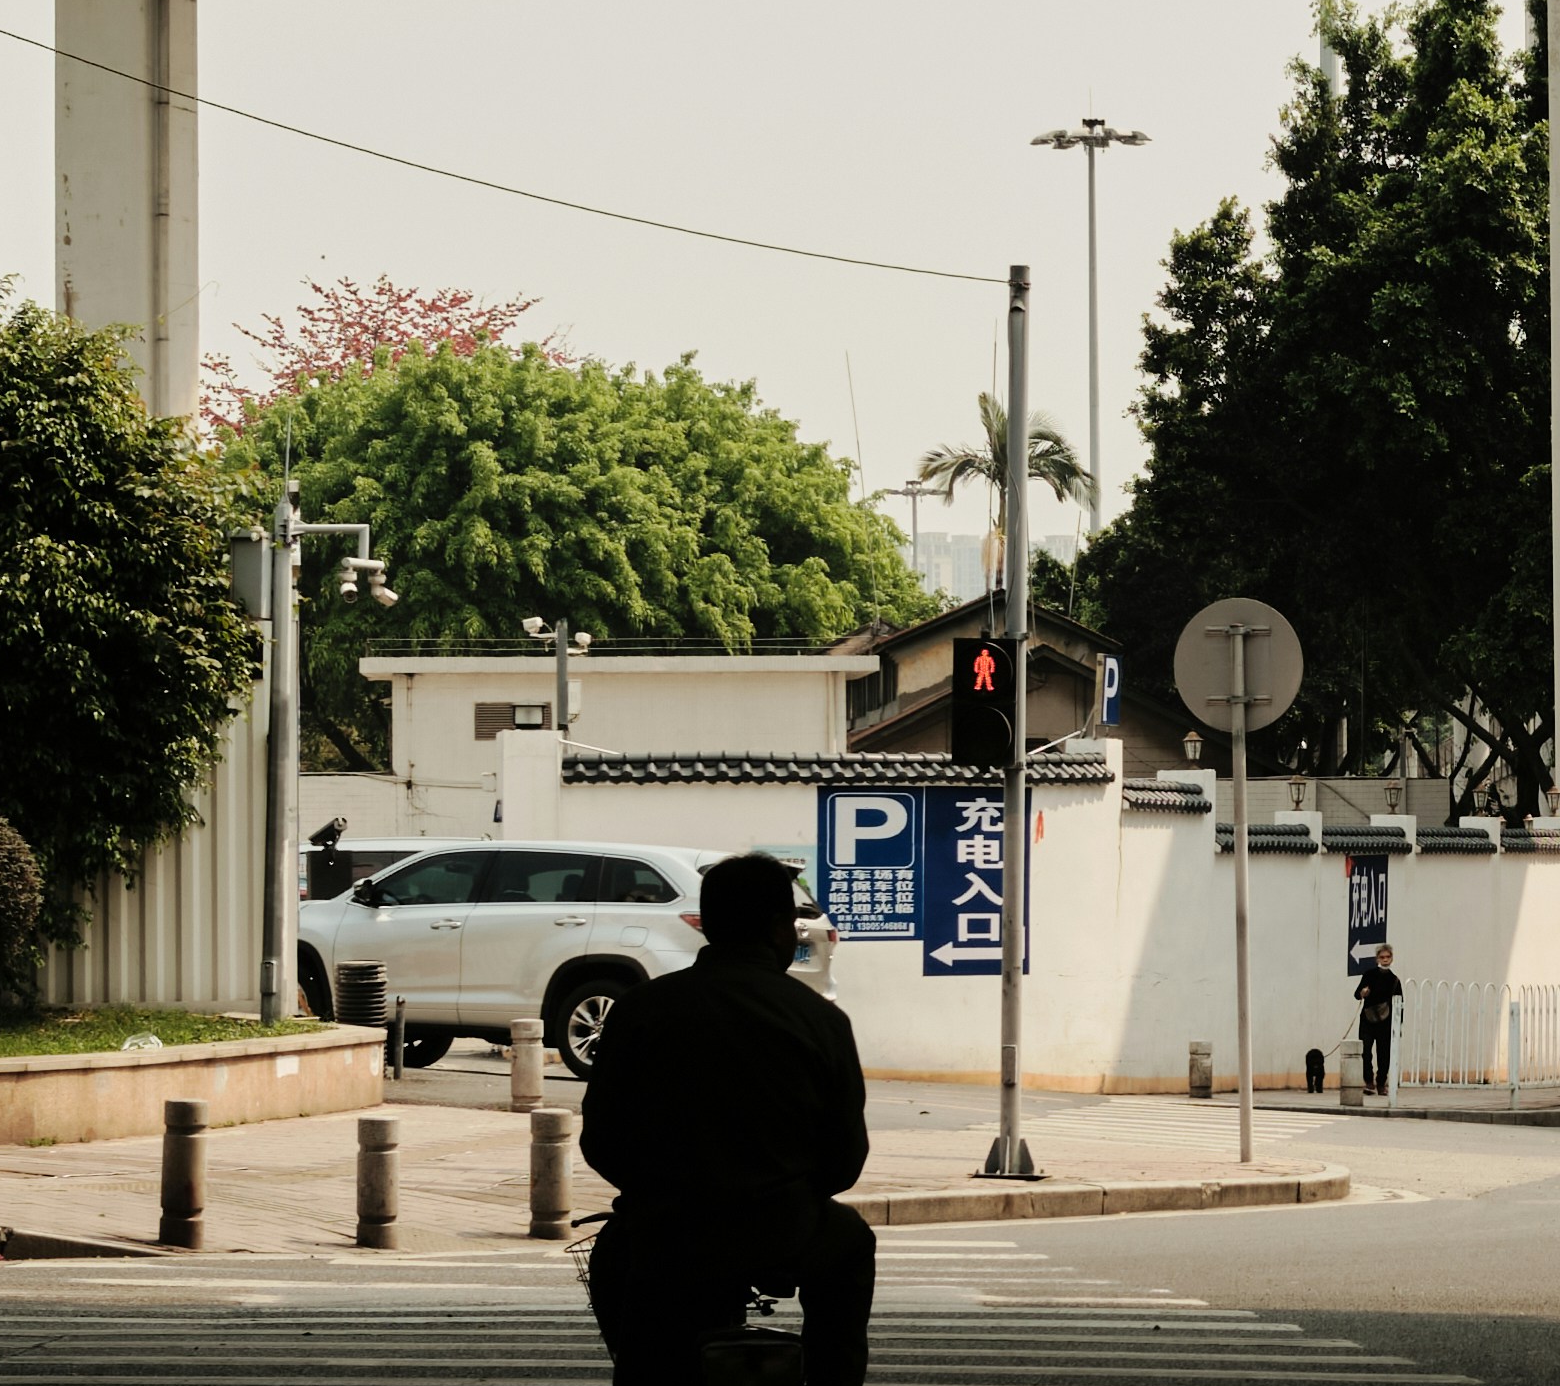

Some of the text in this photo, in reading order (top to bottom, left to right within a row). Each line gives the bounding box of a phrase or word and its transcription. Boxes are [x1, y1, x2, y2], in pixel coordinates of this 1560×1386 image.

[1103, 657, 1119, 721] P
[835, 796, 908, 865] P
[828, 870, 915, 880] 本车场有
[829, 881, 915, 891] 月保车位
[952, 797, 1006, 942] 充电入口
[828, 892, 915, 903] 临保车位
[828, 903, 915, 914] 欢迎光临
[1351, 866, 1386, 929] 充电入口
